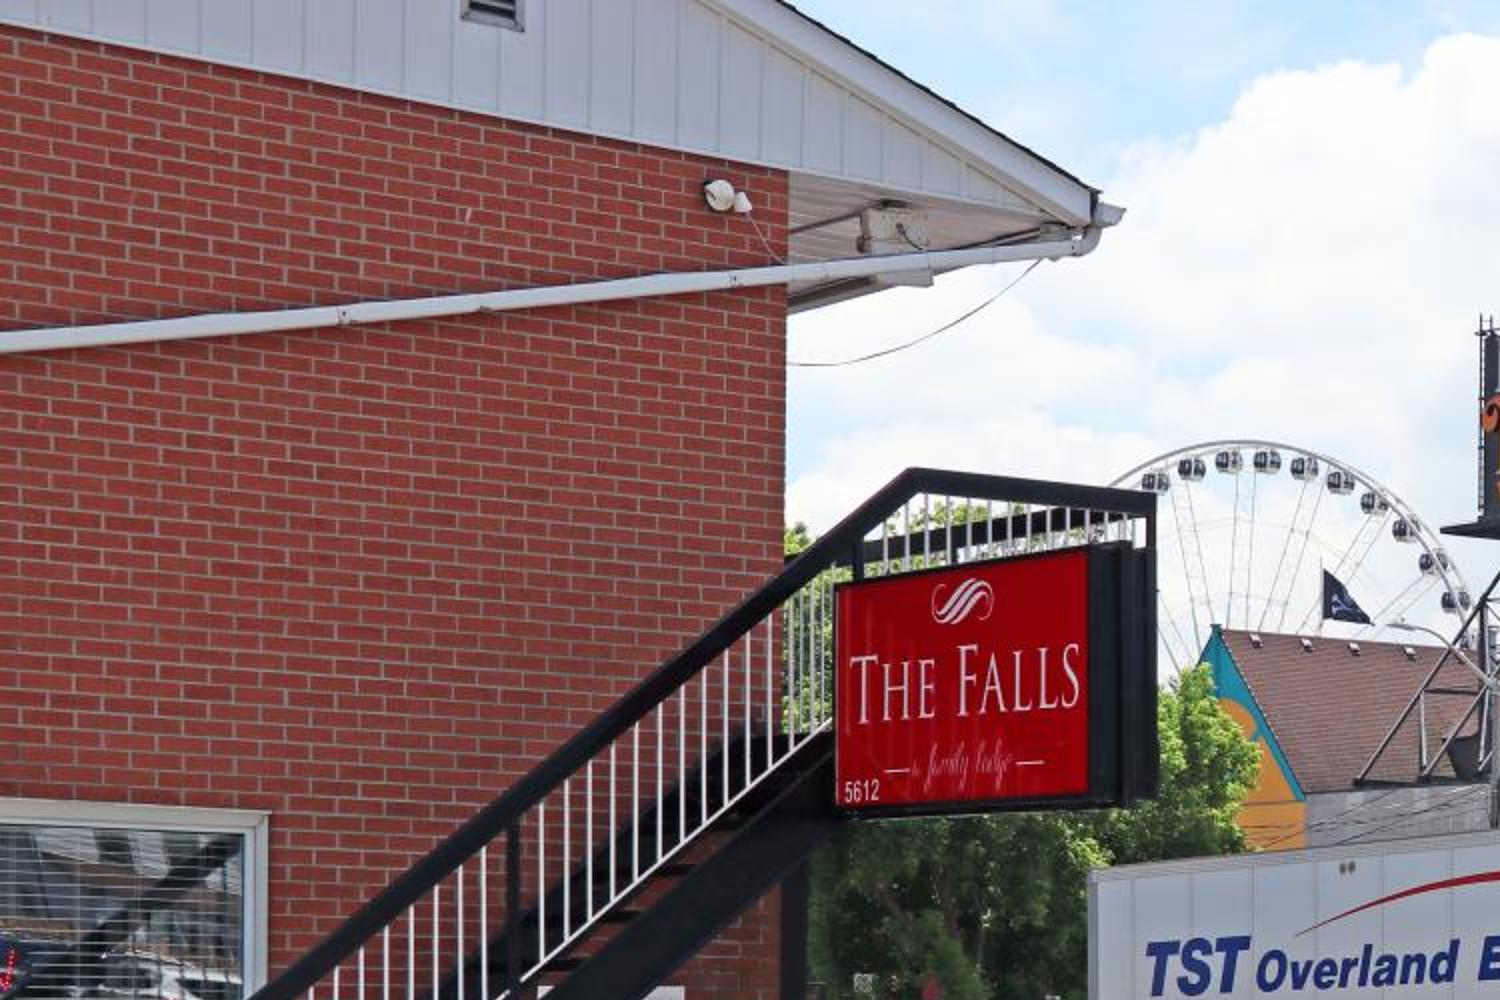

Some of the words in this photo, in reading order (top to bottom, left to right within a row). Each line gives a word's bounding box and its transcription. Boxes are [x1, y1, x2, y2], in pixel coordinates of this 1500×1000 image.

[850, 655, 936, 725] THE
[956, 643, 1080, 717] FALLS
[845, 779, 880, 803] 5612
[1145, 935, 1252, 997] TST
[1255, 939, 1460, 993] Overland
